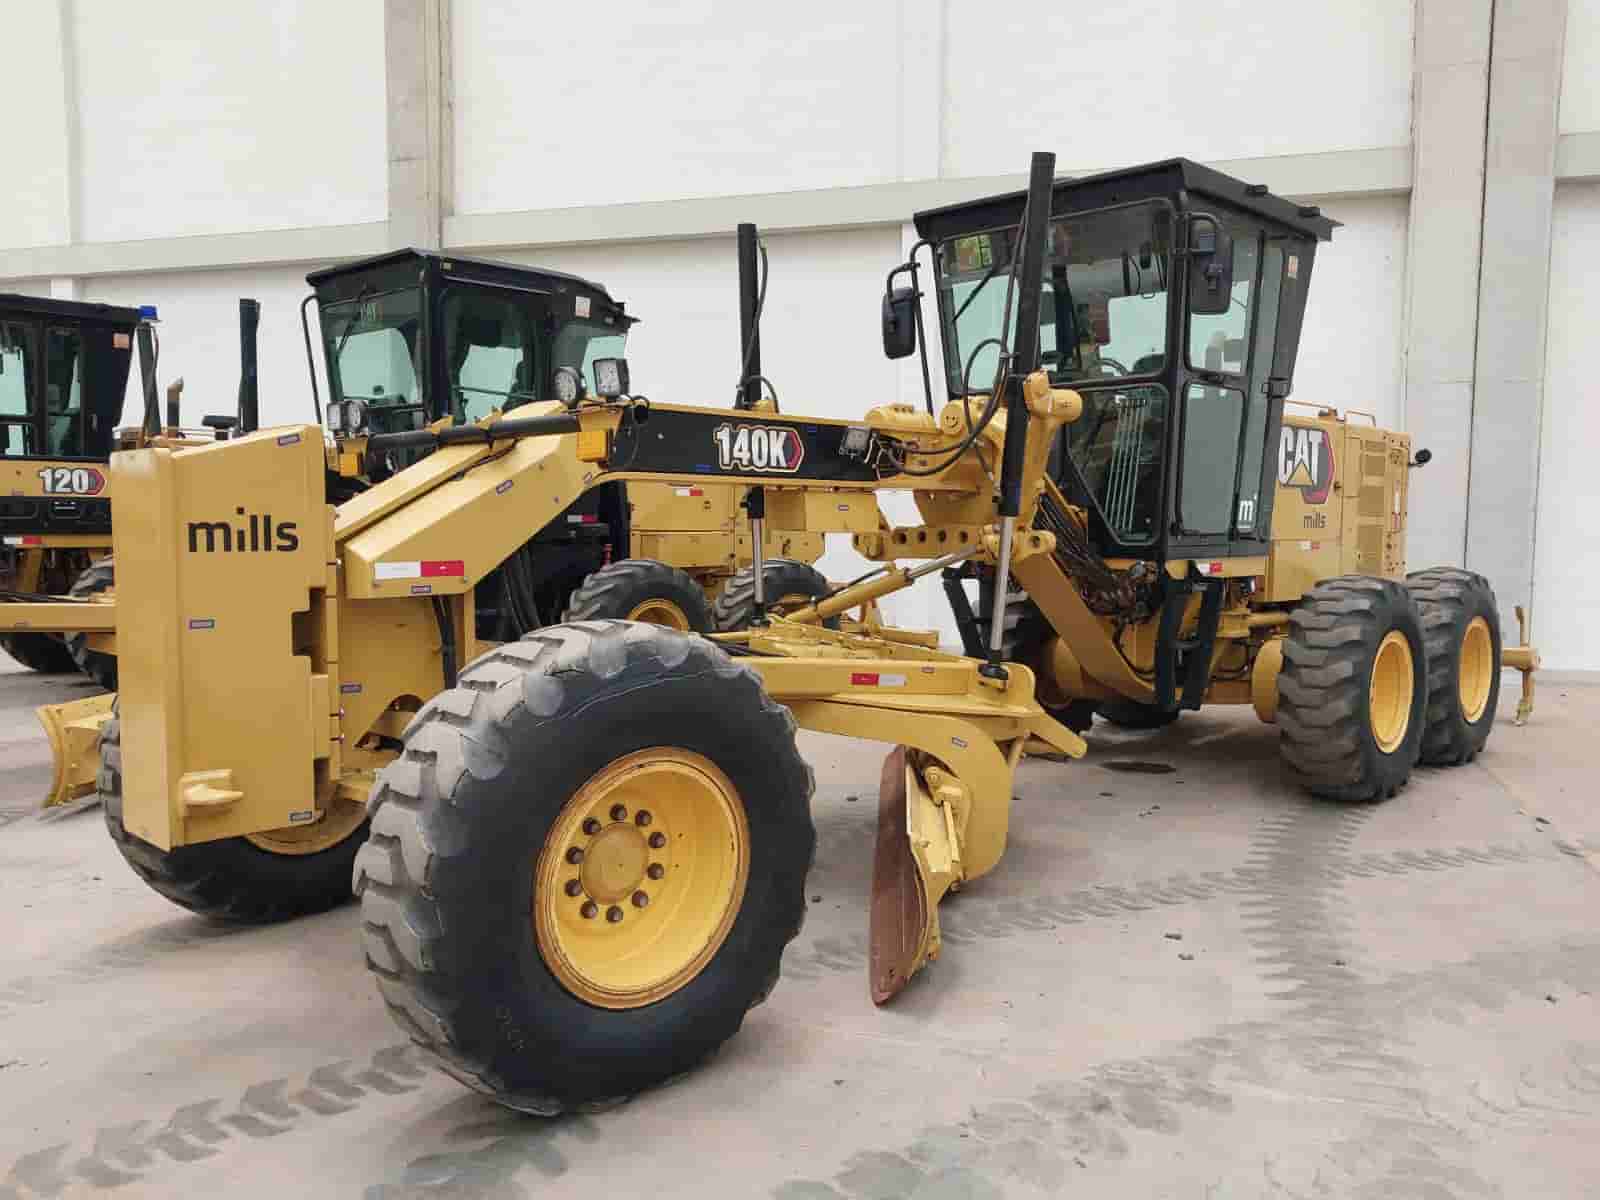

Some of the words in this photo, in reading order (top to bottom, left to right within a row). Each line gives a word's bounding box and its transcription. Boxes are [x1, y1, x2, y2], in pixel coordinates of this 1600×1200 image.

[717, 428, 787, 467] 140K
[1279, 427, 1322, 486] CAT
[187, 506, 298, 552] mills
[1304, 512, 1326, 528] mills
